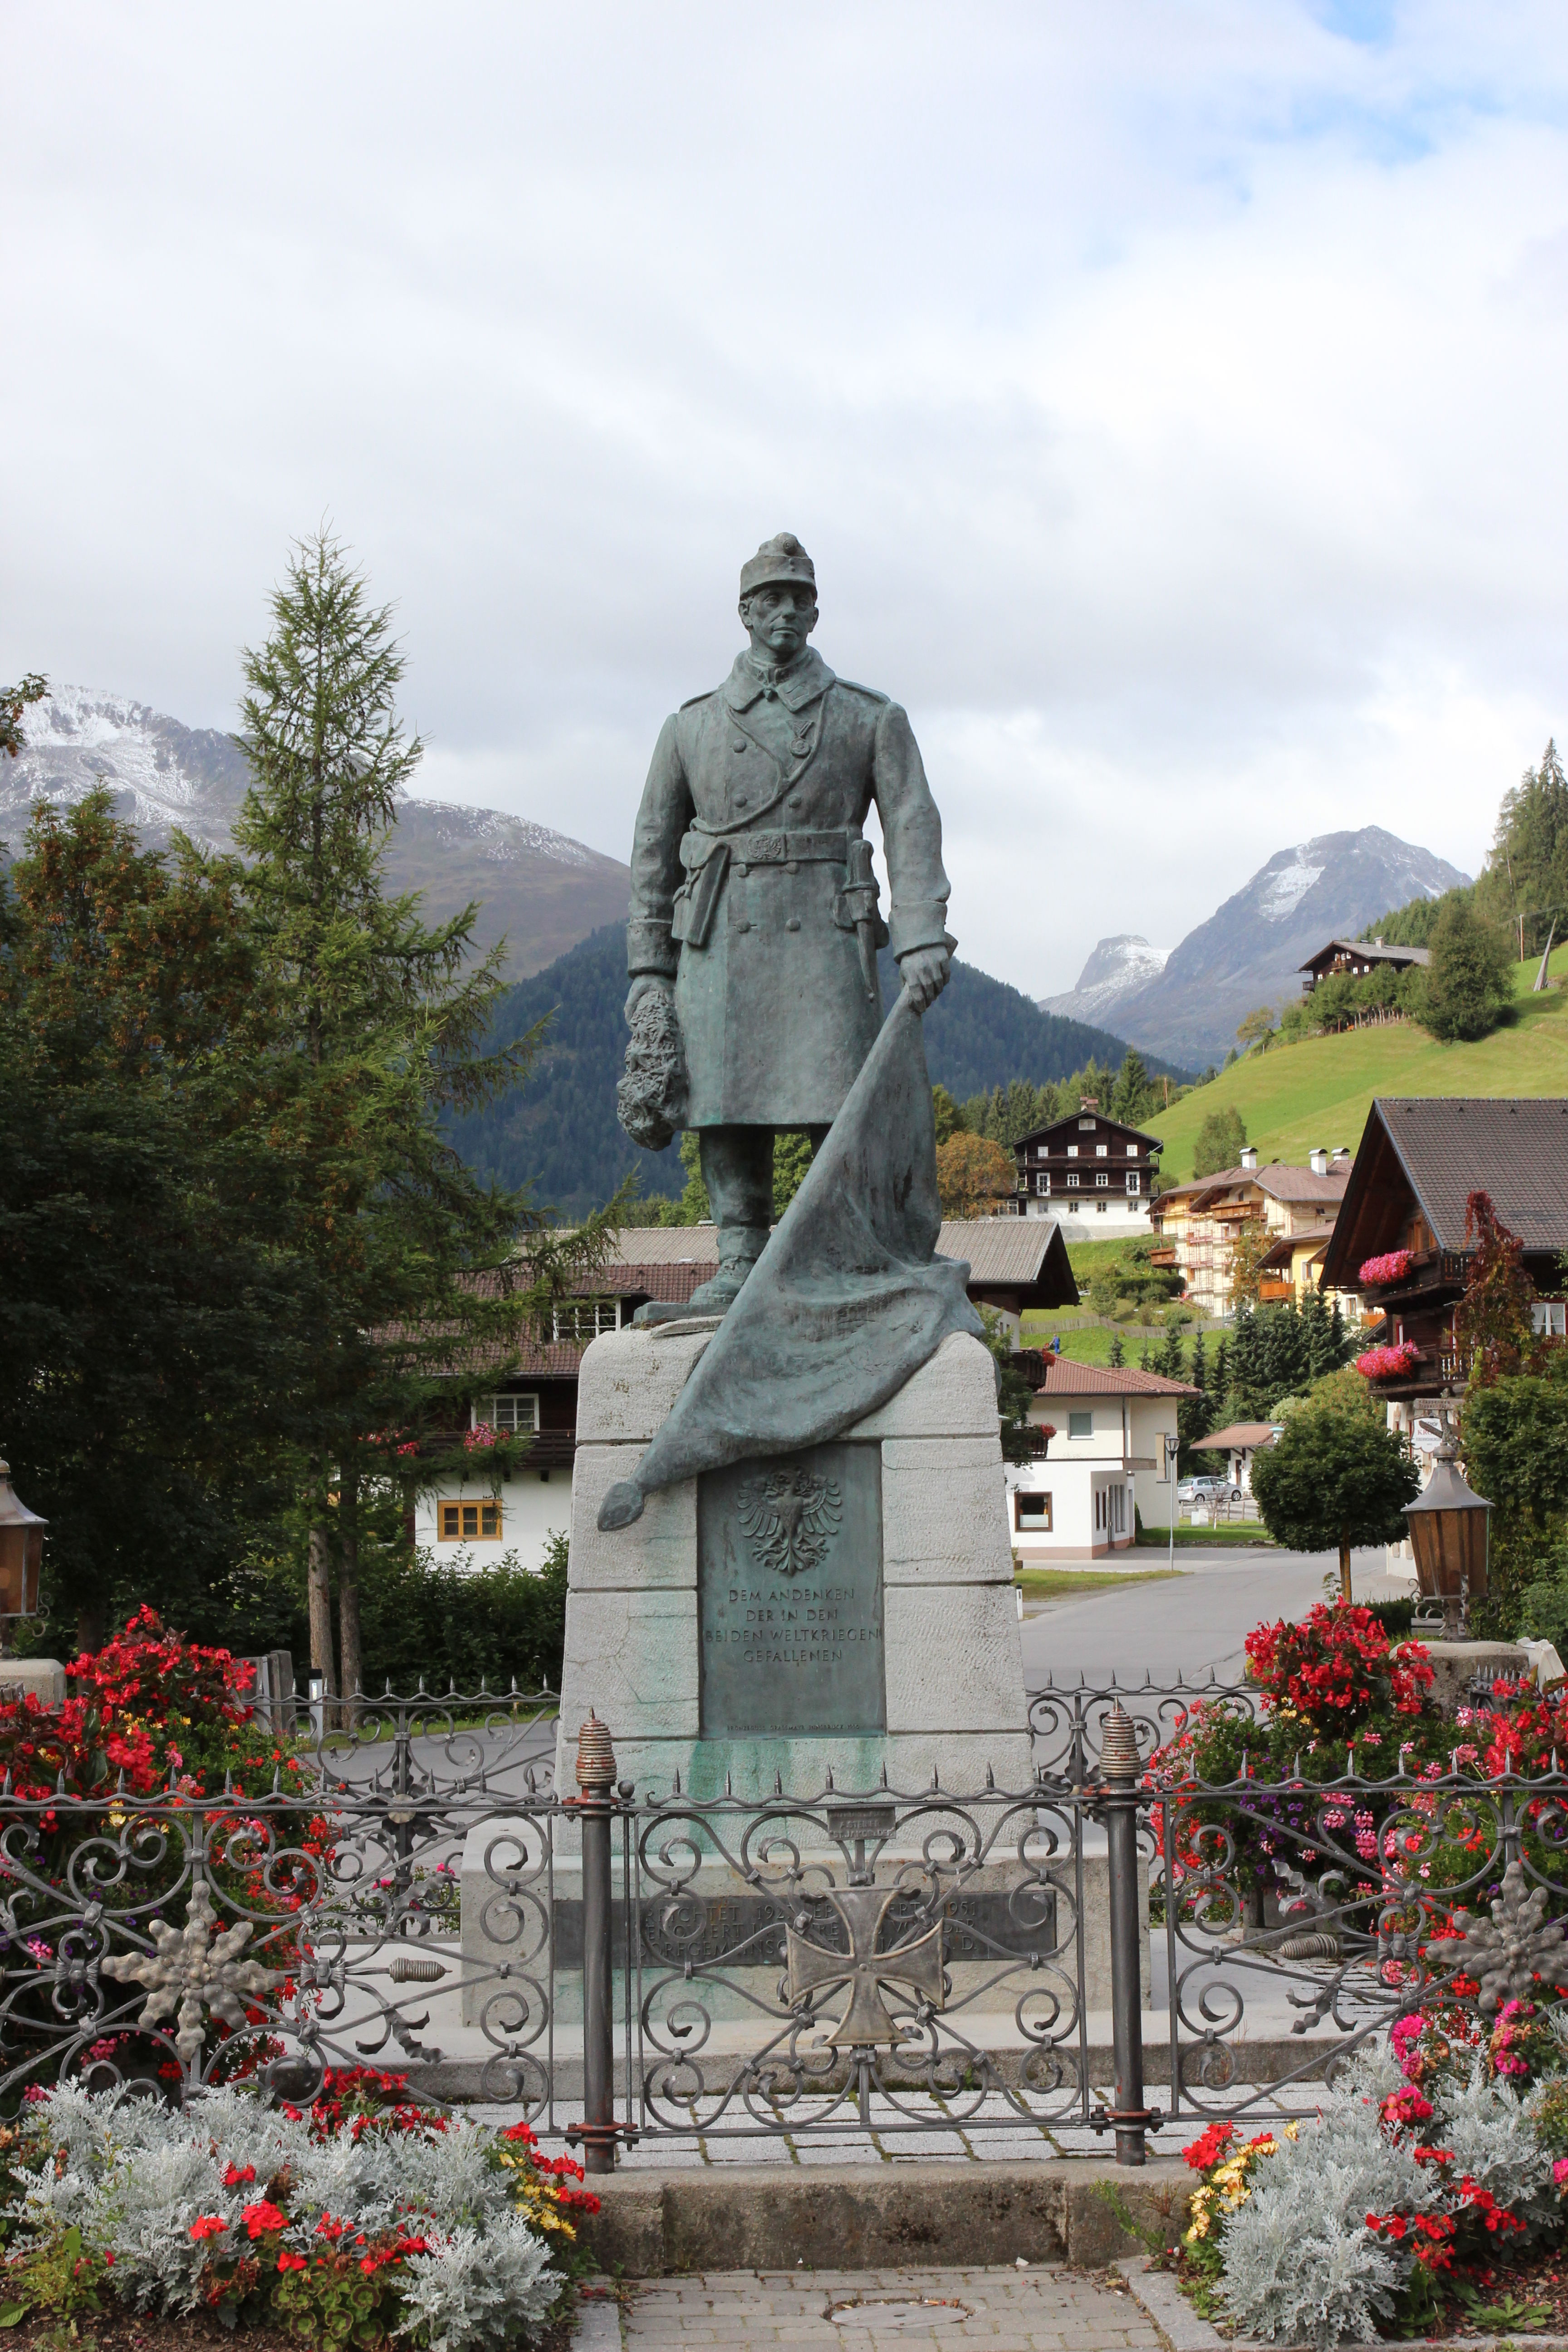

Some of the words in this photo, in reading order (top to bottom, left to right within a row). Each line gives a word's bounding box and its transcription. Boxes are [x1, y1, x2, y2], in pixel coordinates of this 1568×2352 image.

[729, 1589, 761, 1602] DEM
[768, 1588, 855, 1601] ANDENKEN
[746, 1609, 773, 1622] DER
[781, 1609, 798, 1621] IN
[806, 1608, 838, 1621] DEN
[706, 1630, 763, 1642] BEIDEN
[771, 1628, 879, 1641] WELTKRIEGEN
[743, 1649, 842, 1662] GEFALLENEN
[645, 1906, 740, 1924] RRICHTET
[756, 1904, 793, 1921] 192
[941, 1901, 976, 1916] 1951
